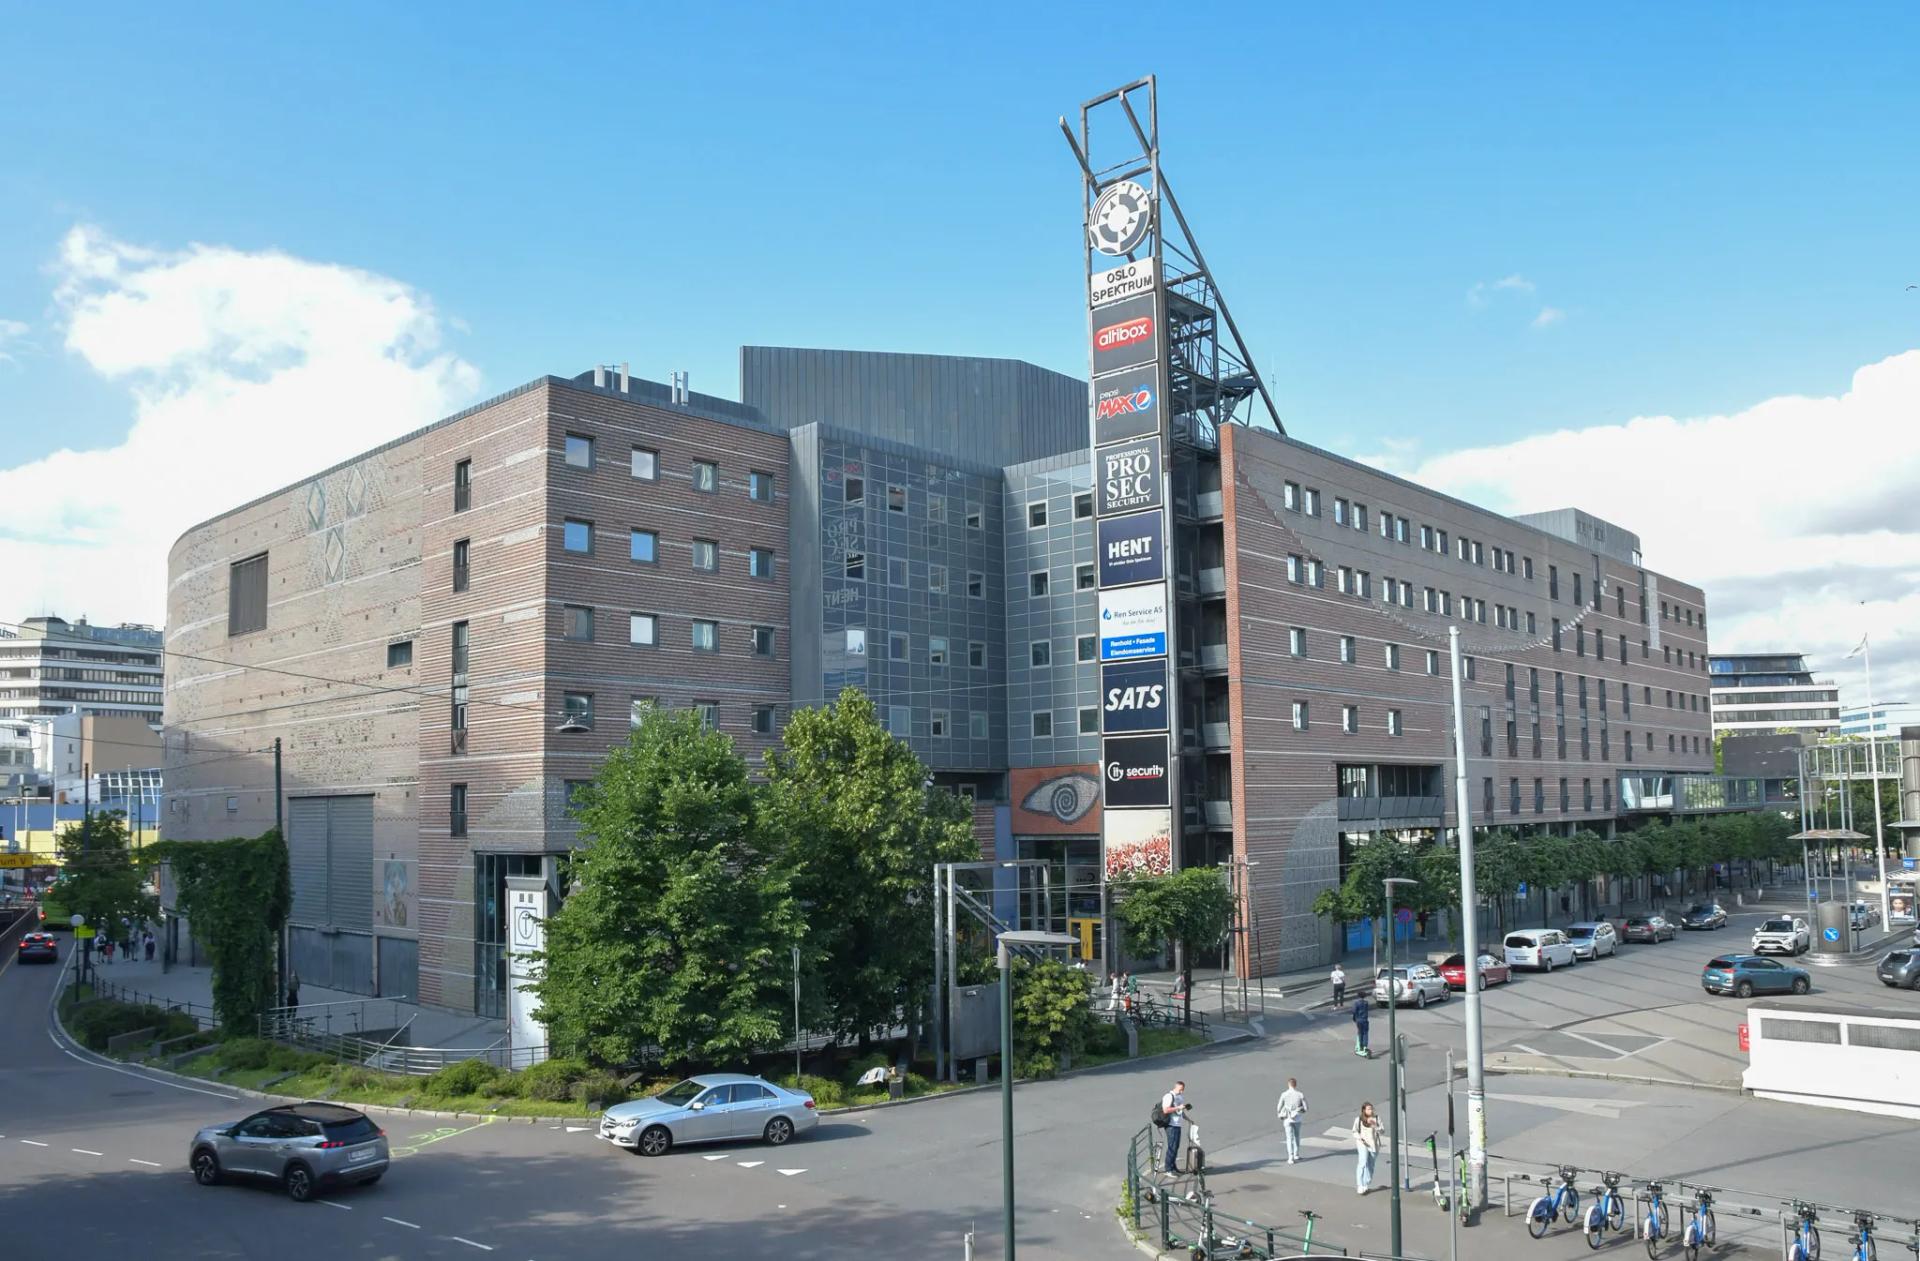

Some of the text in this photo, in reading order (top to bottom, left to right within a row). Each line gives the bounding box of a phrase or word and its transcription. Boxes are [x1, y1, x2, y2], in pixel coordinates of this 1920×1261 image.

[1107, 266, 1136, 283] OSLO
[1092, 275, 1153, 302] SPEKTRUM
[1099, 323, 1148, 346] altibox
[1100, 388, 1119, 400] pepsi
[1096, 392, 1137, 420] MAX
[1105, 447, 1150, 461] PROFESSIONAL
[1106, 454, 1151, 480] PRO
[1106, 473, 1151, 501] SEC
[1106, 494, 1152, 509] SECURITY
[1108, 536, 1152, 559] HENT
[1128, 608, 1152, 616] Service
[1154, 606, 1163, 614] AS
[1105, 684, 1164, 712] SATS
[1107, 761, 1164, 782] City security
